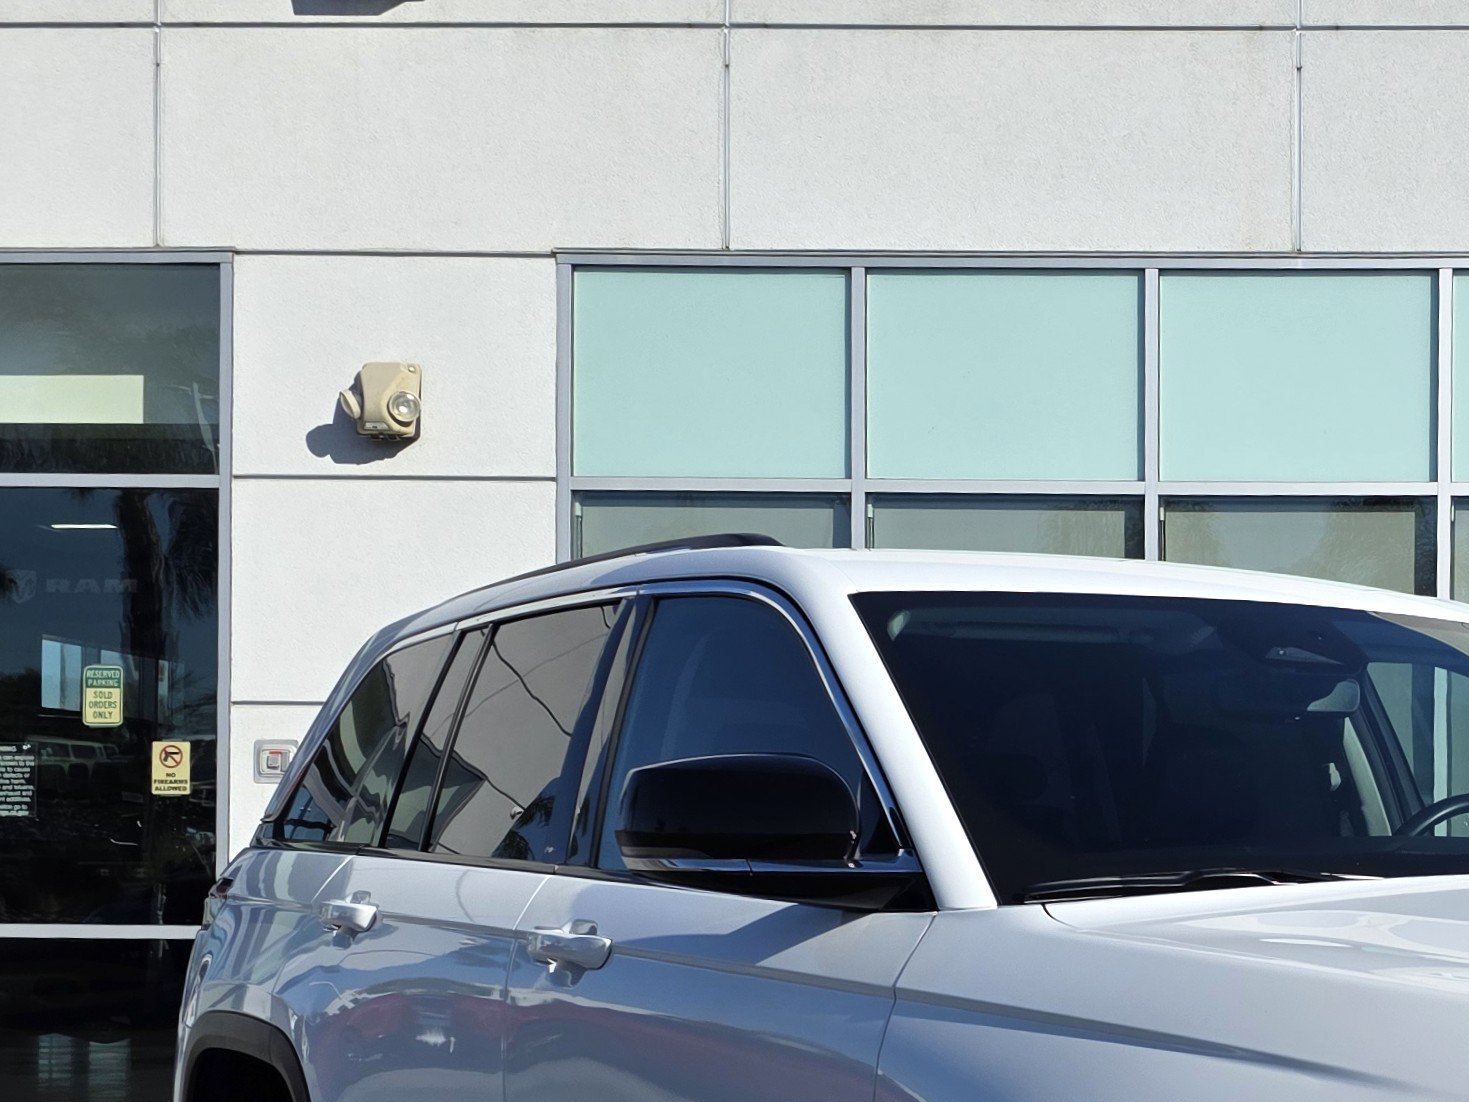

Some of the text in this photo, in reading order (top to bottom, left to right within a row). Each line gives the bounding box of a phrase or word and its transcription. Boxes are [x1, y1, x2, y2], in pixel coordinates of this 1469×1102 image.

[87, 670, 120, 678] RESERVED
[87, 679, 119, 687] PARKING
[93, 691, 113, 700] SOLD
[88, 700, 118, 709] ORDERS
[92, 711, 113, 719] ONLY
